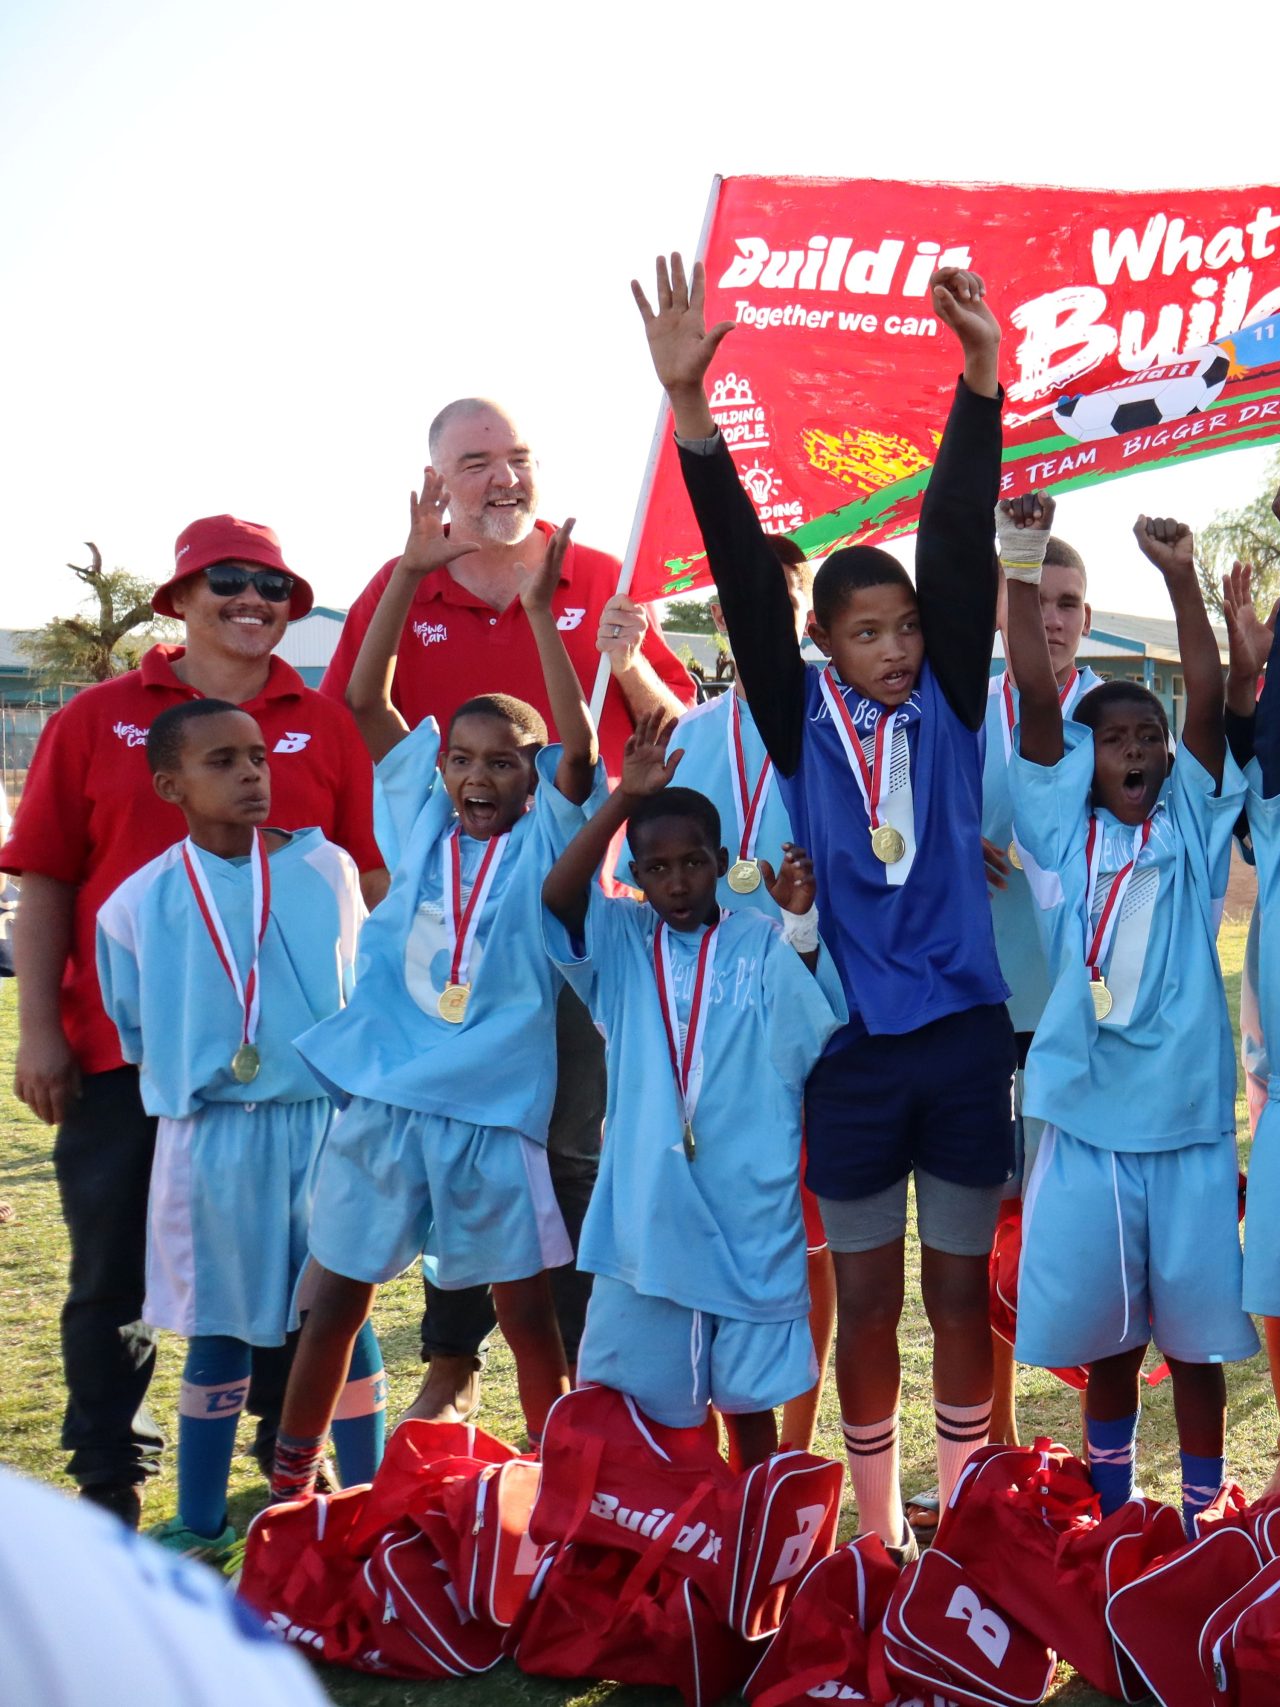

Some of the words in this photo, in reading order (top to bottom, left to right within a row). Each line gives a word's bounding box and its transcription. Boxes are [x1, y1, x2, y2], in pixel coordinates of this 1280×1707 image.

[718, 236, 904, 295] Build
[734, 301, 833, 330] Together
[838, 312, 878, 333] we
[884, 315, 938, 337] can
[1253, 324, 1275, 341] 11
[1168, 364, 1191, 377] it
[712, 406, 766, 426] UILDING
[721, 424, 770, 444] OPLE.
[1026, 448, 1097, 483] TEAM
[1122, 413, 1227, 458] BIGGER
[557, 608, 587, 631] B
[113, 721, 135, 739] Yes
[127, 733, 148, 747] Ca
[272, 731, 312, 753] B
[589, 1492, 706, 1553] Build
[697, 1529, 723, 1564] it
[769, 1503, 826, 1585] B
[945, 1584, 1011, 1669] B
